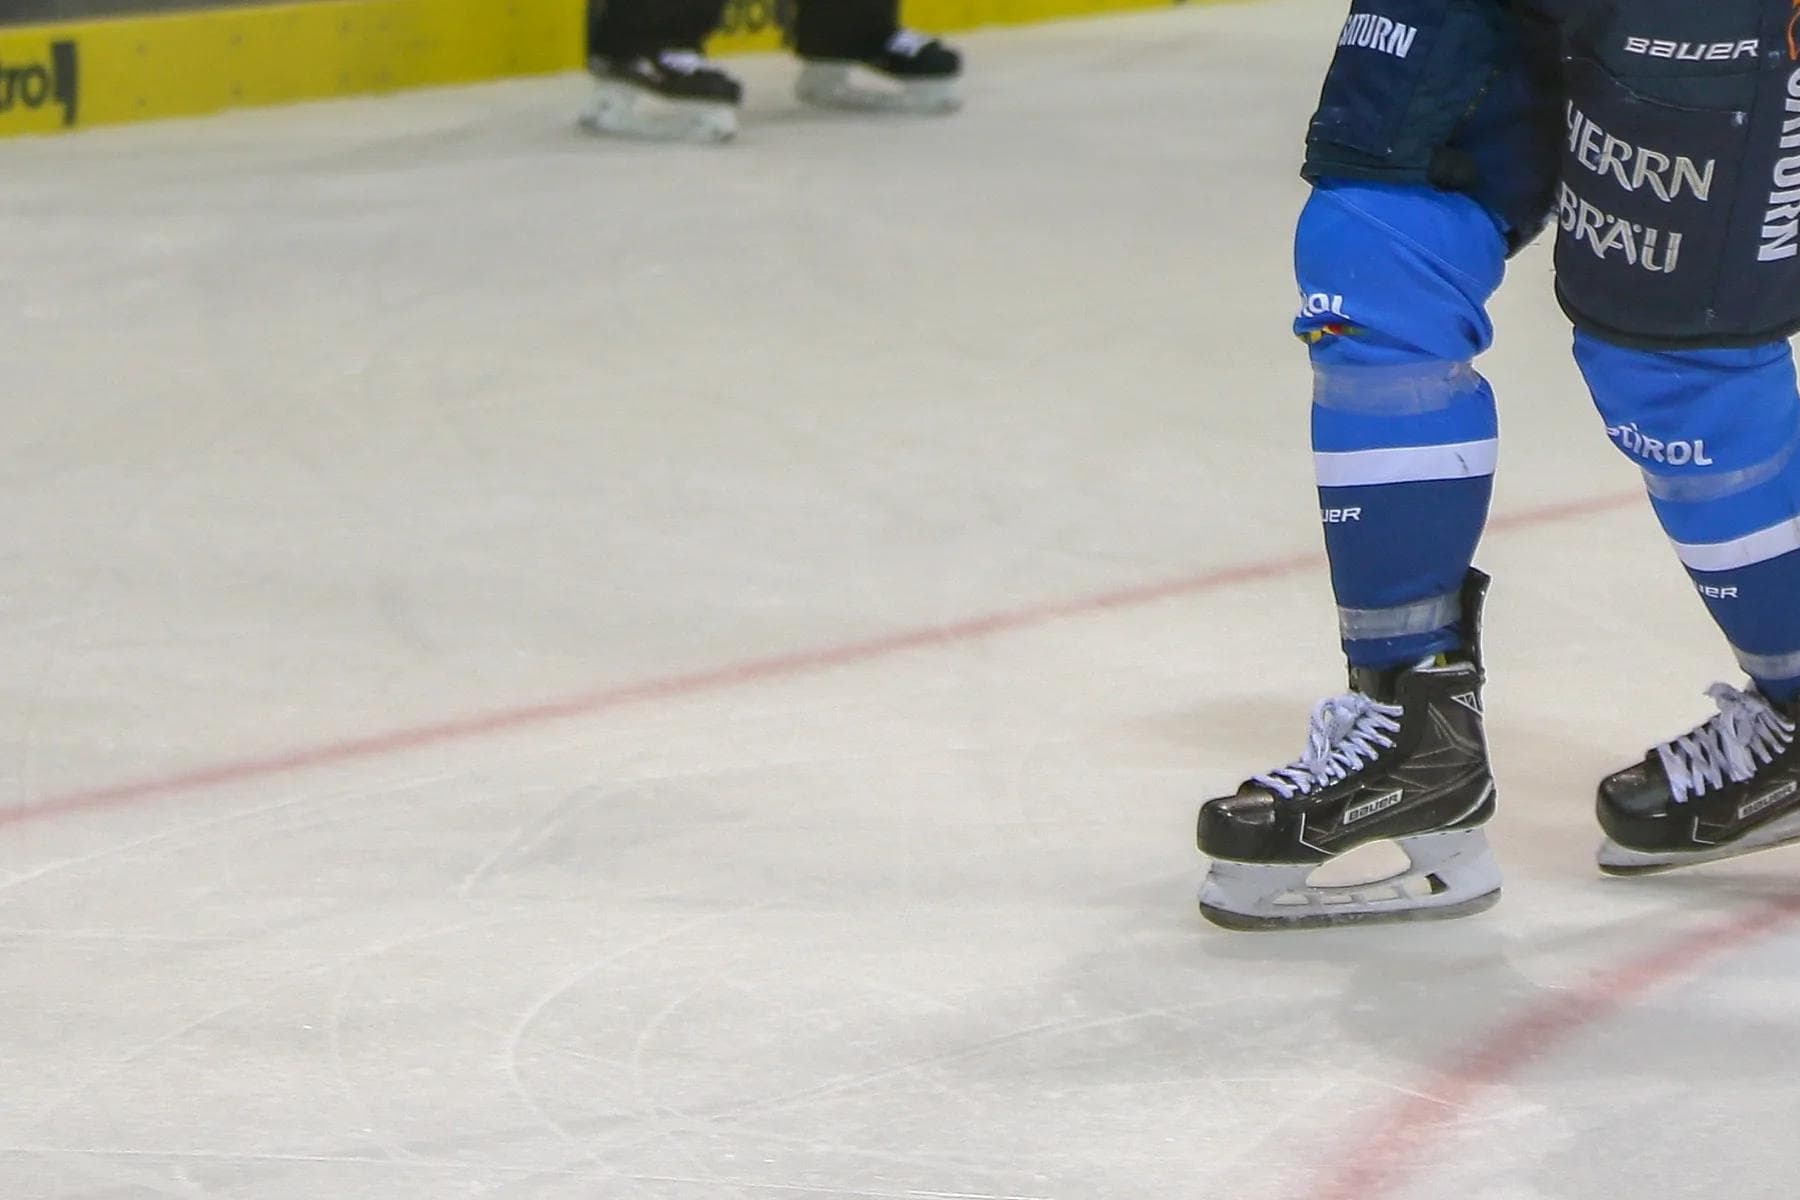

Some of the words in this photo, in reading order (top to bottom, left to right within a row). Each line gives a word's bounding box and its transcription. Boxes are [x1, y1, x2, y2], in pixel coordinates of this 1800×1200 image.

[1624, 36, 1760, 62] BAUER
[1566, 98, 1716, 203] HERRN
[1559, 180, 1683, 274] BRÄU
[1348, 792, 1400, 822] BAUER
